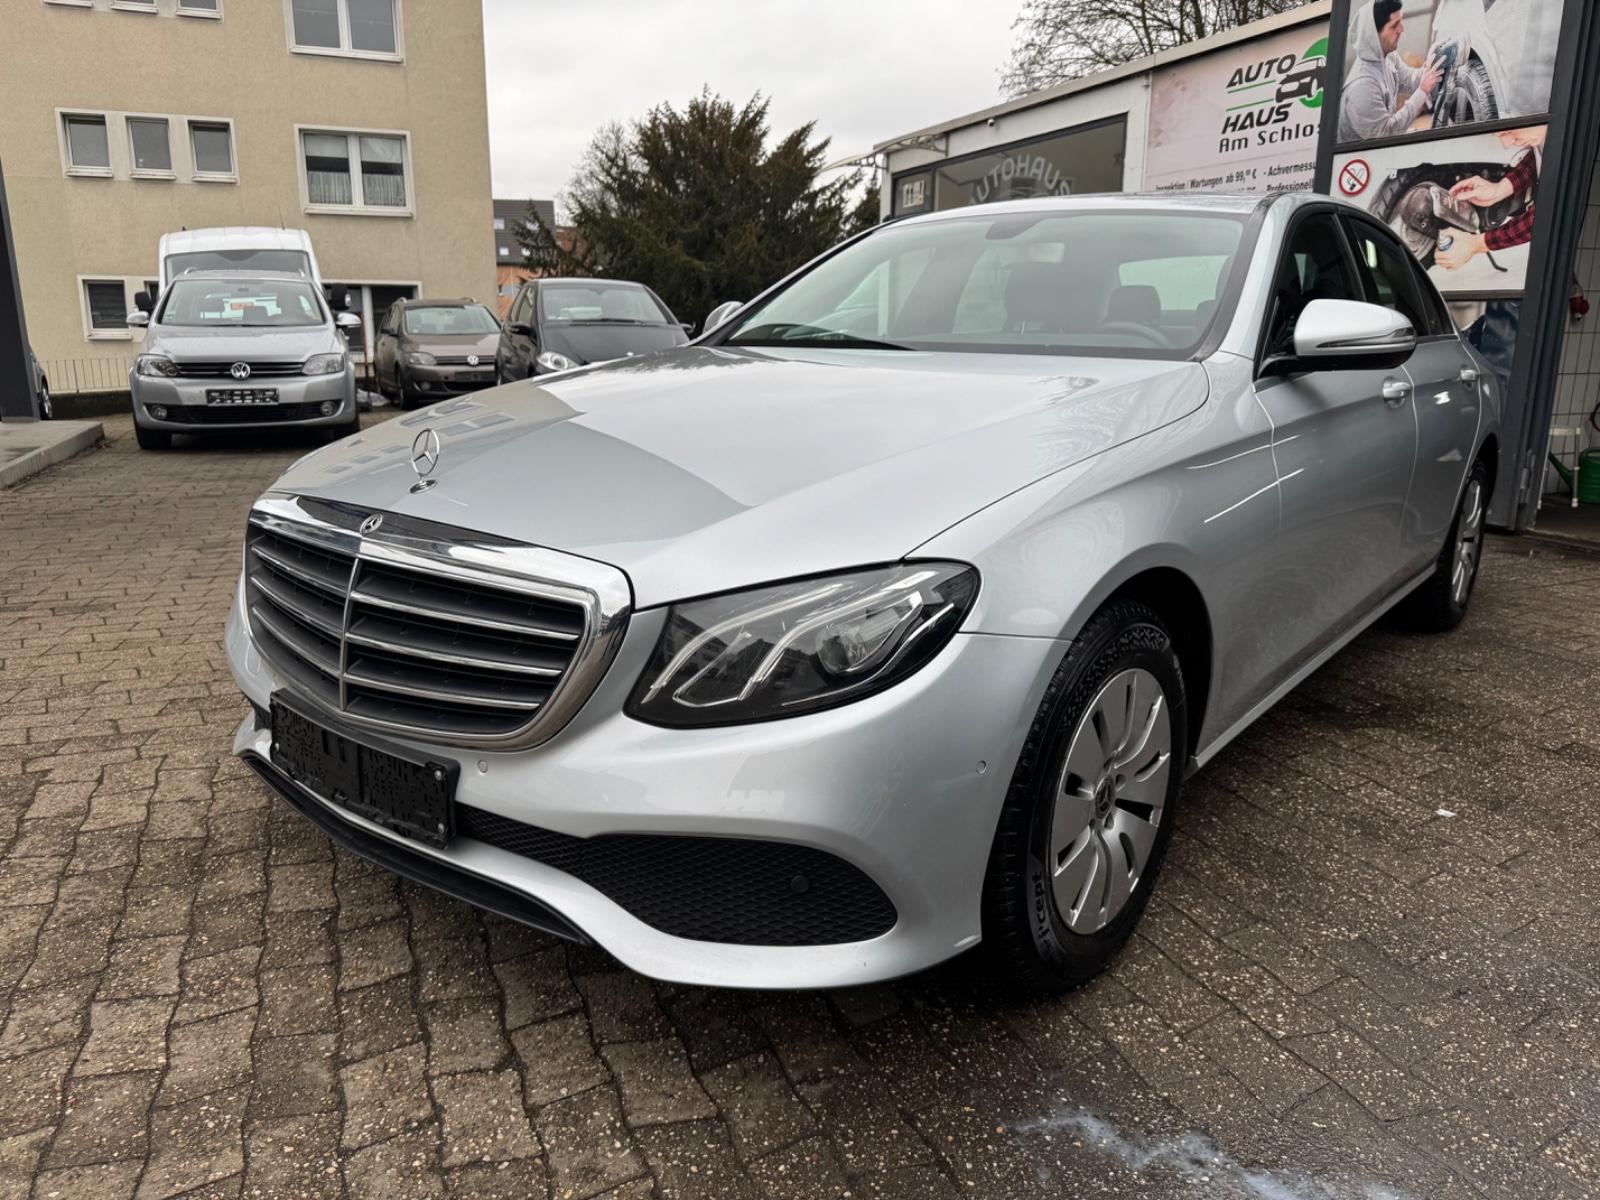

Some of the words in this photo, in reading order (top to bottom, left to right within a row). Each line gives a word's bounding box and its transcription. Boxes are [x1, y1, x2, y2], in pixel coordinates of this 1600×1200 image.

[1226, 54, 1296, 88] AUTO
[1221, 102, 1293, 134] HAUS
[1219, 137, 1248, 153] Am
[1257, 123, 1320, 146] Schlo
[1190, 177, 1223, 189] Wartungen
[1226, 173, 1234, 183] ab
